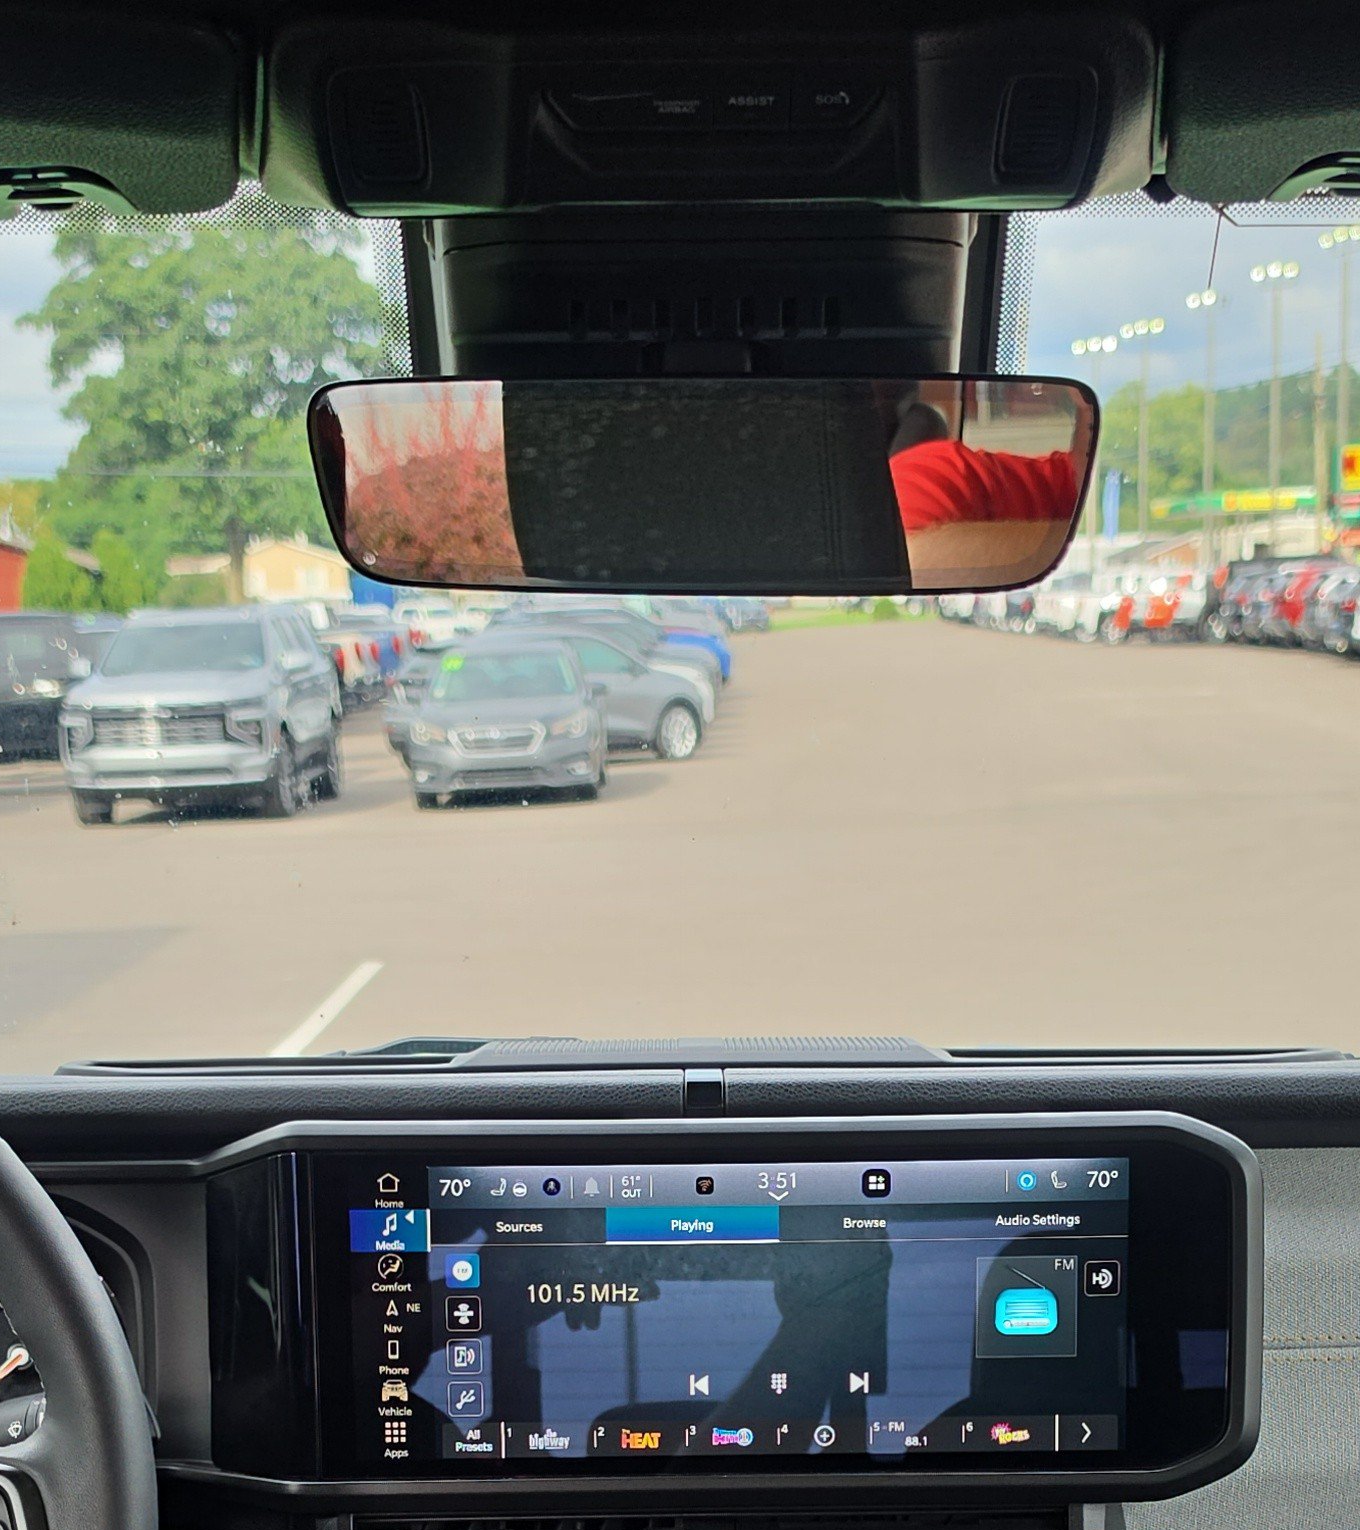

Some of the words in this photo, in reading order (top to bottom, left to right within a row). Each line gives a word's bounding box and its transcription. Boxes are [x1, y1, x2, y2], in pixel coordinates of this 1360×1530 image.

[728, 96, 774, 106] ASSIST
[757, 1171, 798, 1189] 3:51
[1086, 1170, 1119, 1188] 70°
[439, 1179, 471, 1197] 70°
[621, 1188, 642, 1198] OUT
[375, 1199, 404, 1209] Home
[670, 1218, 714, 1233] Playing
[843, 1216, 887, 1229] Browse
[995, 1213, 1031, 1227] Audio
[1032, 1212, 1081, 1229] Settings
[495, 1221, 543, 1233] Sources
[375, 1240, 405, 1251] Media
[1054, 1258, 1075, 1271] FM
[371, 1282, 412, 1293] Comfort
[526, 1283, 586, 1304] 101.5
[590, 1283, 640, 1302] MHz
[405, 1302, 422, 1313] NE
[383, 1323, 403, 1334] Nav
[379, 1366, 410, 1376] Phone
[378, 1406, 413, 1417] Vehicle
[597, 1426, 605, 1437] 2
[689, 1425, 697, 1436] 3
[780, 1424, 789, 1434] 4
[966, 1421, 974, 1432] 6
[466, 1429, 481, 1440] All
[507, 1427, 513, 1438] 1
[621, 1432, 661, 1449] HEAT
[455, 1441, 493, 1453] Presets
[383, 1448, 409, 1459] Apps
